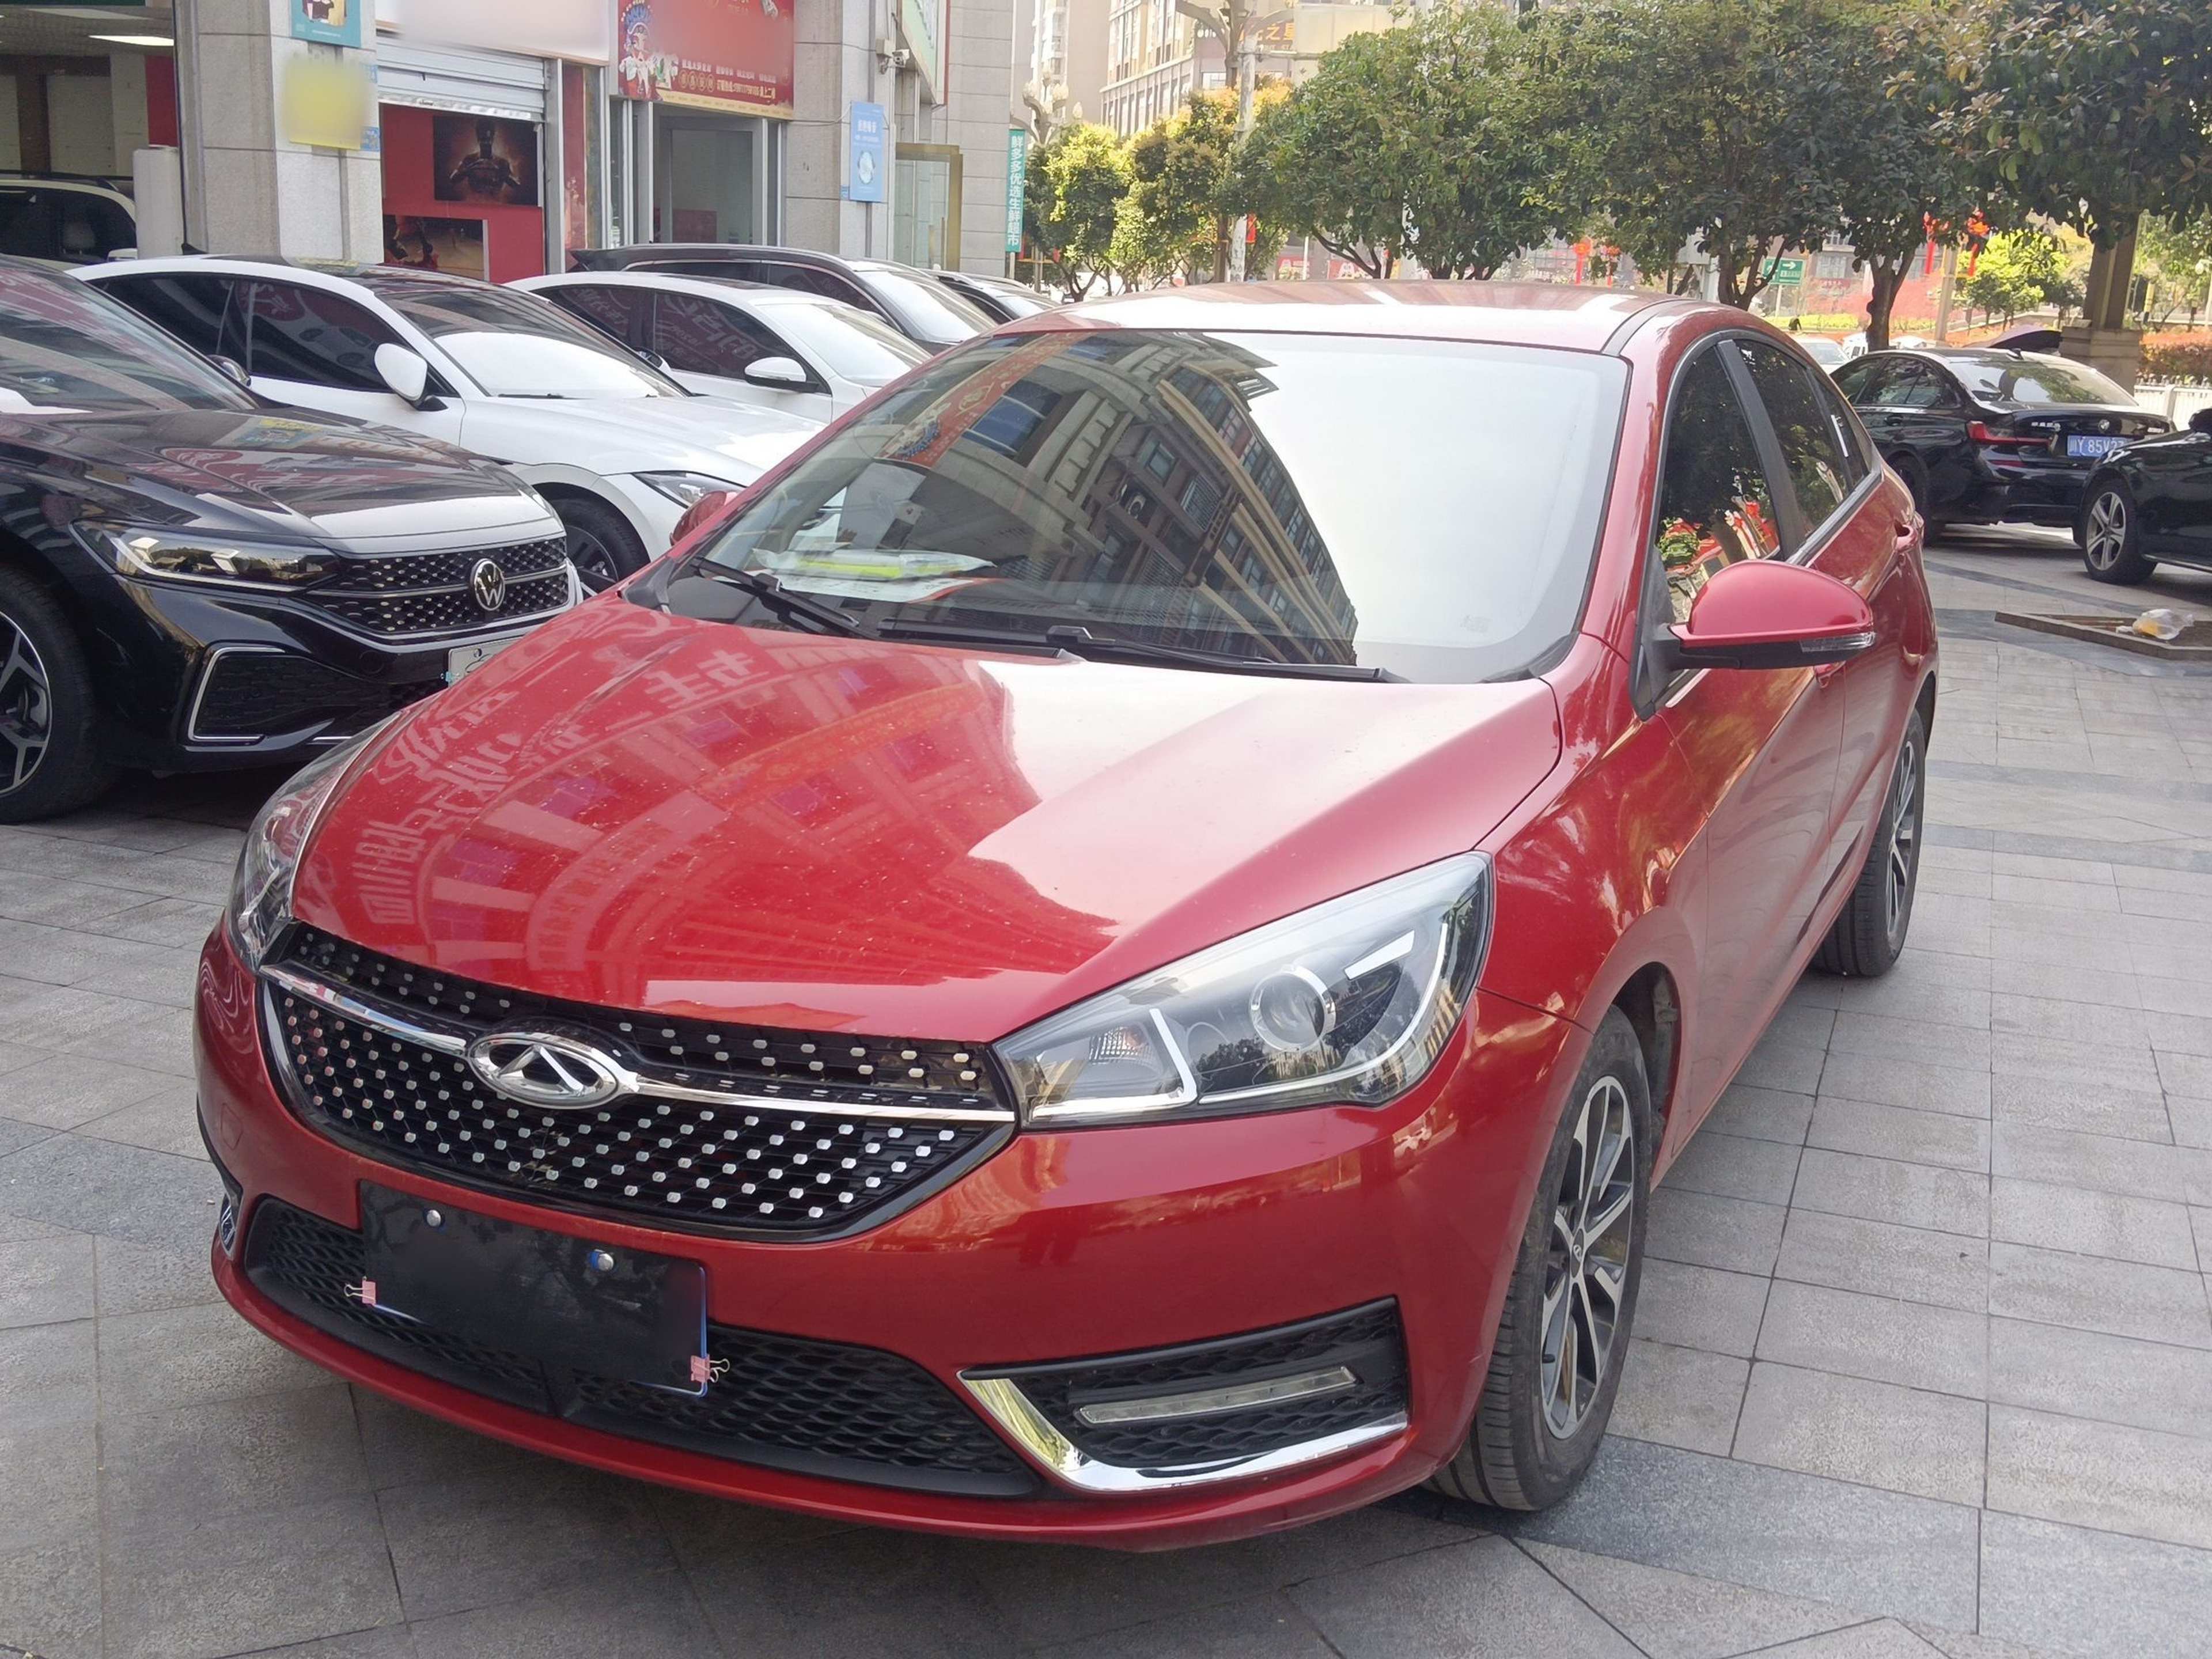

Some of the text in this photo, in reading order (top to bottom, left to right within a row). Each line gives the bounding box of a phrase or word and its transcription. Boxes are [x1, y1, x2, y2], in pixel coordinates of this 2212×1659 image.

[1007, 135, 1024, 247] 鲜多多优选生鲜超市
